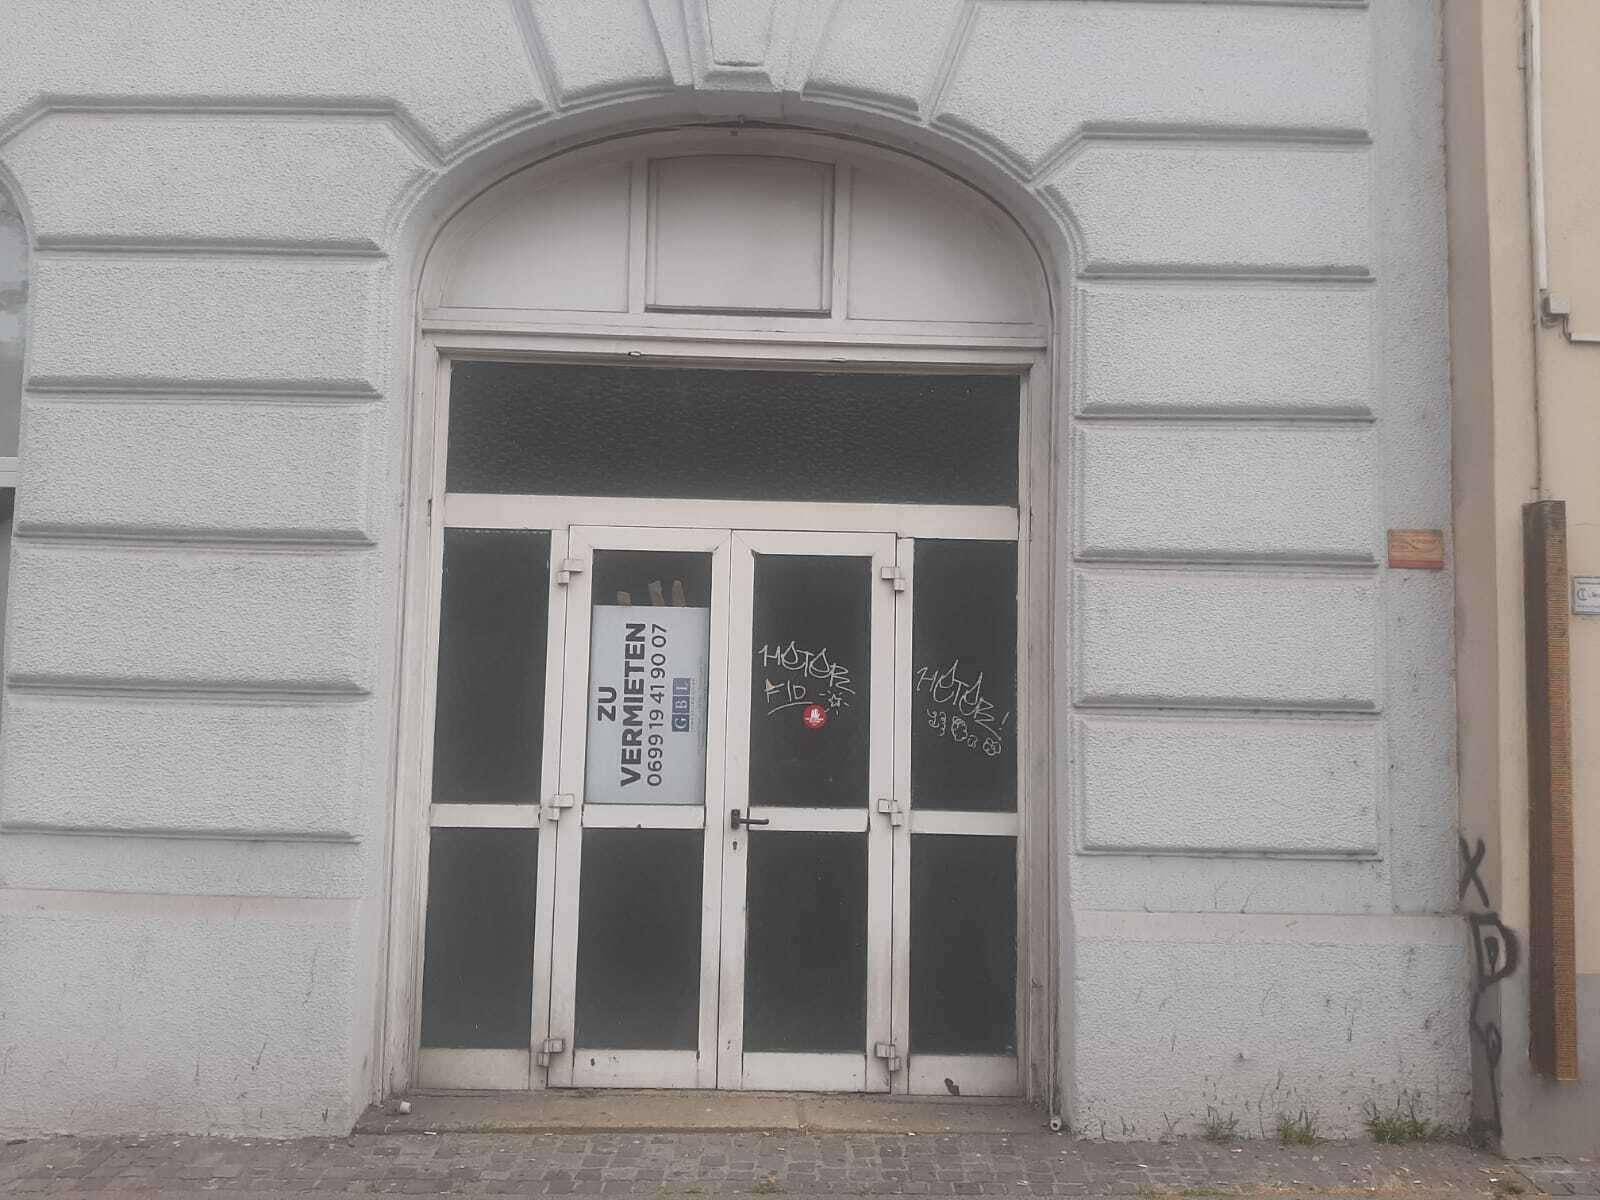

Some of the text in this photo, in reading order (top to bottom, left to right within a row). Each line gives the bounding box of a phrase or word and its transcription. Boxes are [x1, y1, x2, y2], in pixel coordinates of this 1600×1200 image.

[597, 686, 617, 722] ZU
[620, 623, 646, 787] VERMIETEN
[647, 623, 668, 787] 0699 19 41 90 07
